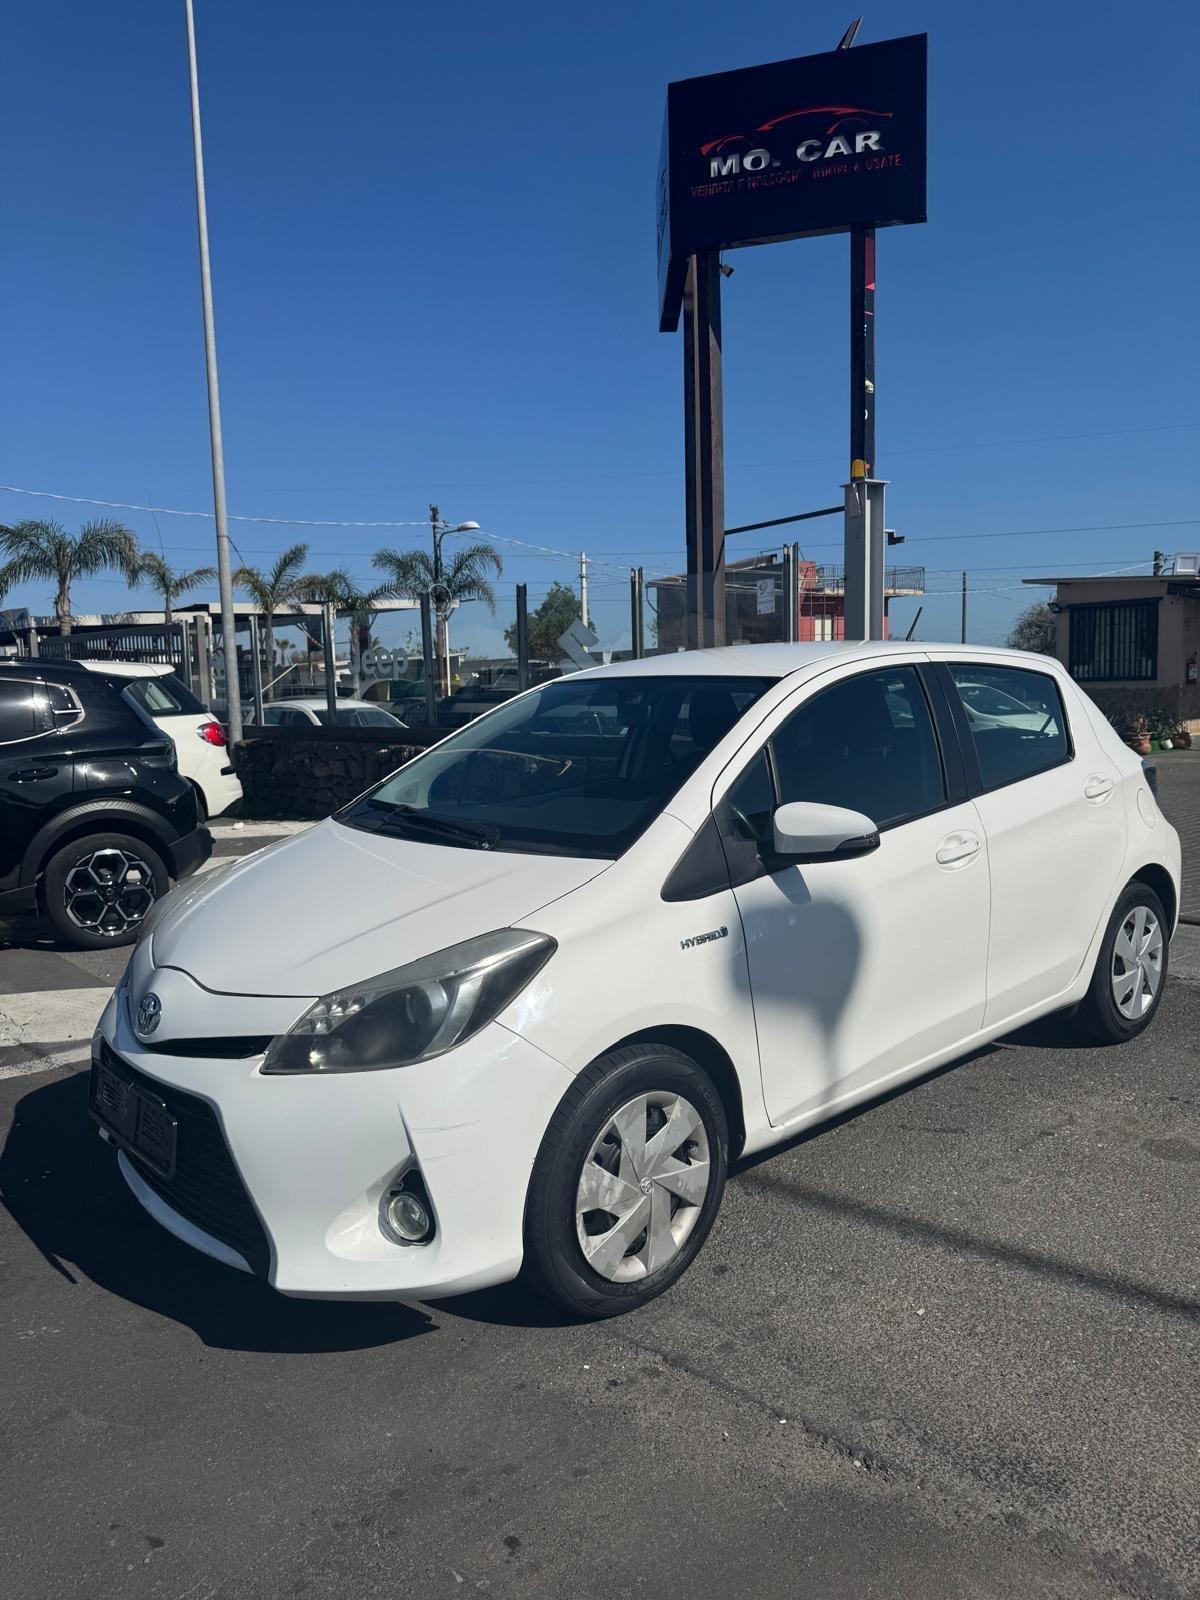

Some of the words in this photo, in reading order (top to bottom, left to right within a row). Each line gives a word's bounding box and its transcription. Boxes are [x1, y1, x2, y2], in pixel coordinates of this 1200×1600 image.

[710, 148, 782, 178] MO.
[796, 129, 883, 162] CAR
[349, 645, 408, 680] Jeep
[680, 929, 721, 950] HYBRID
